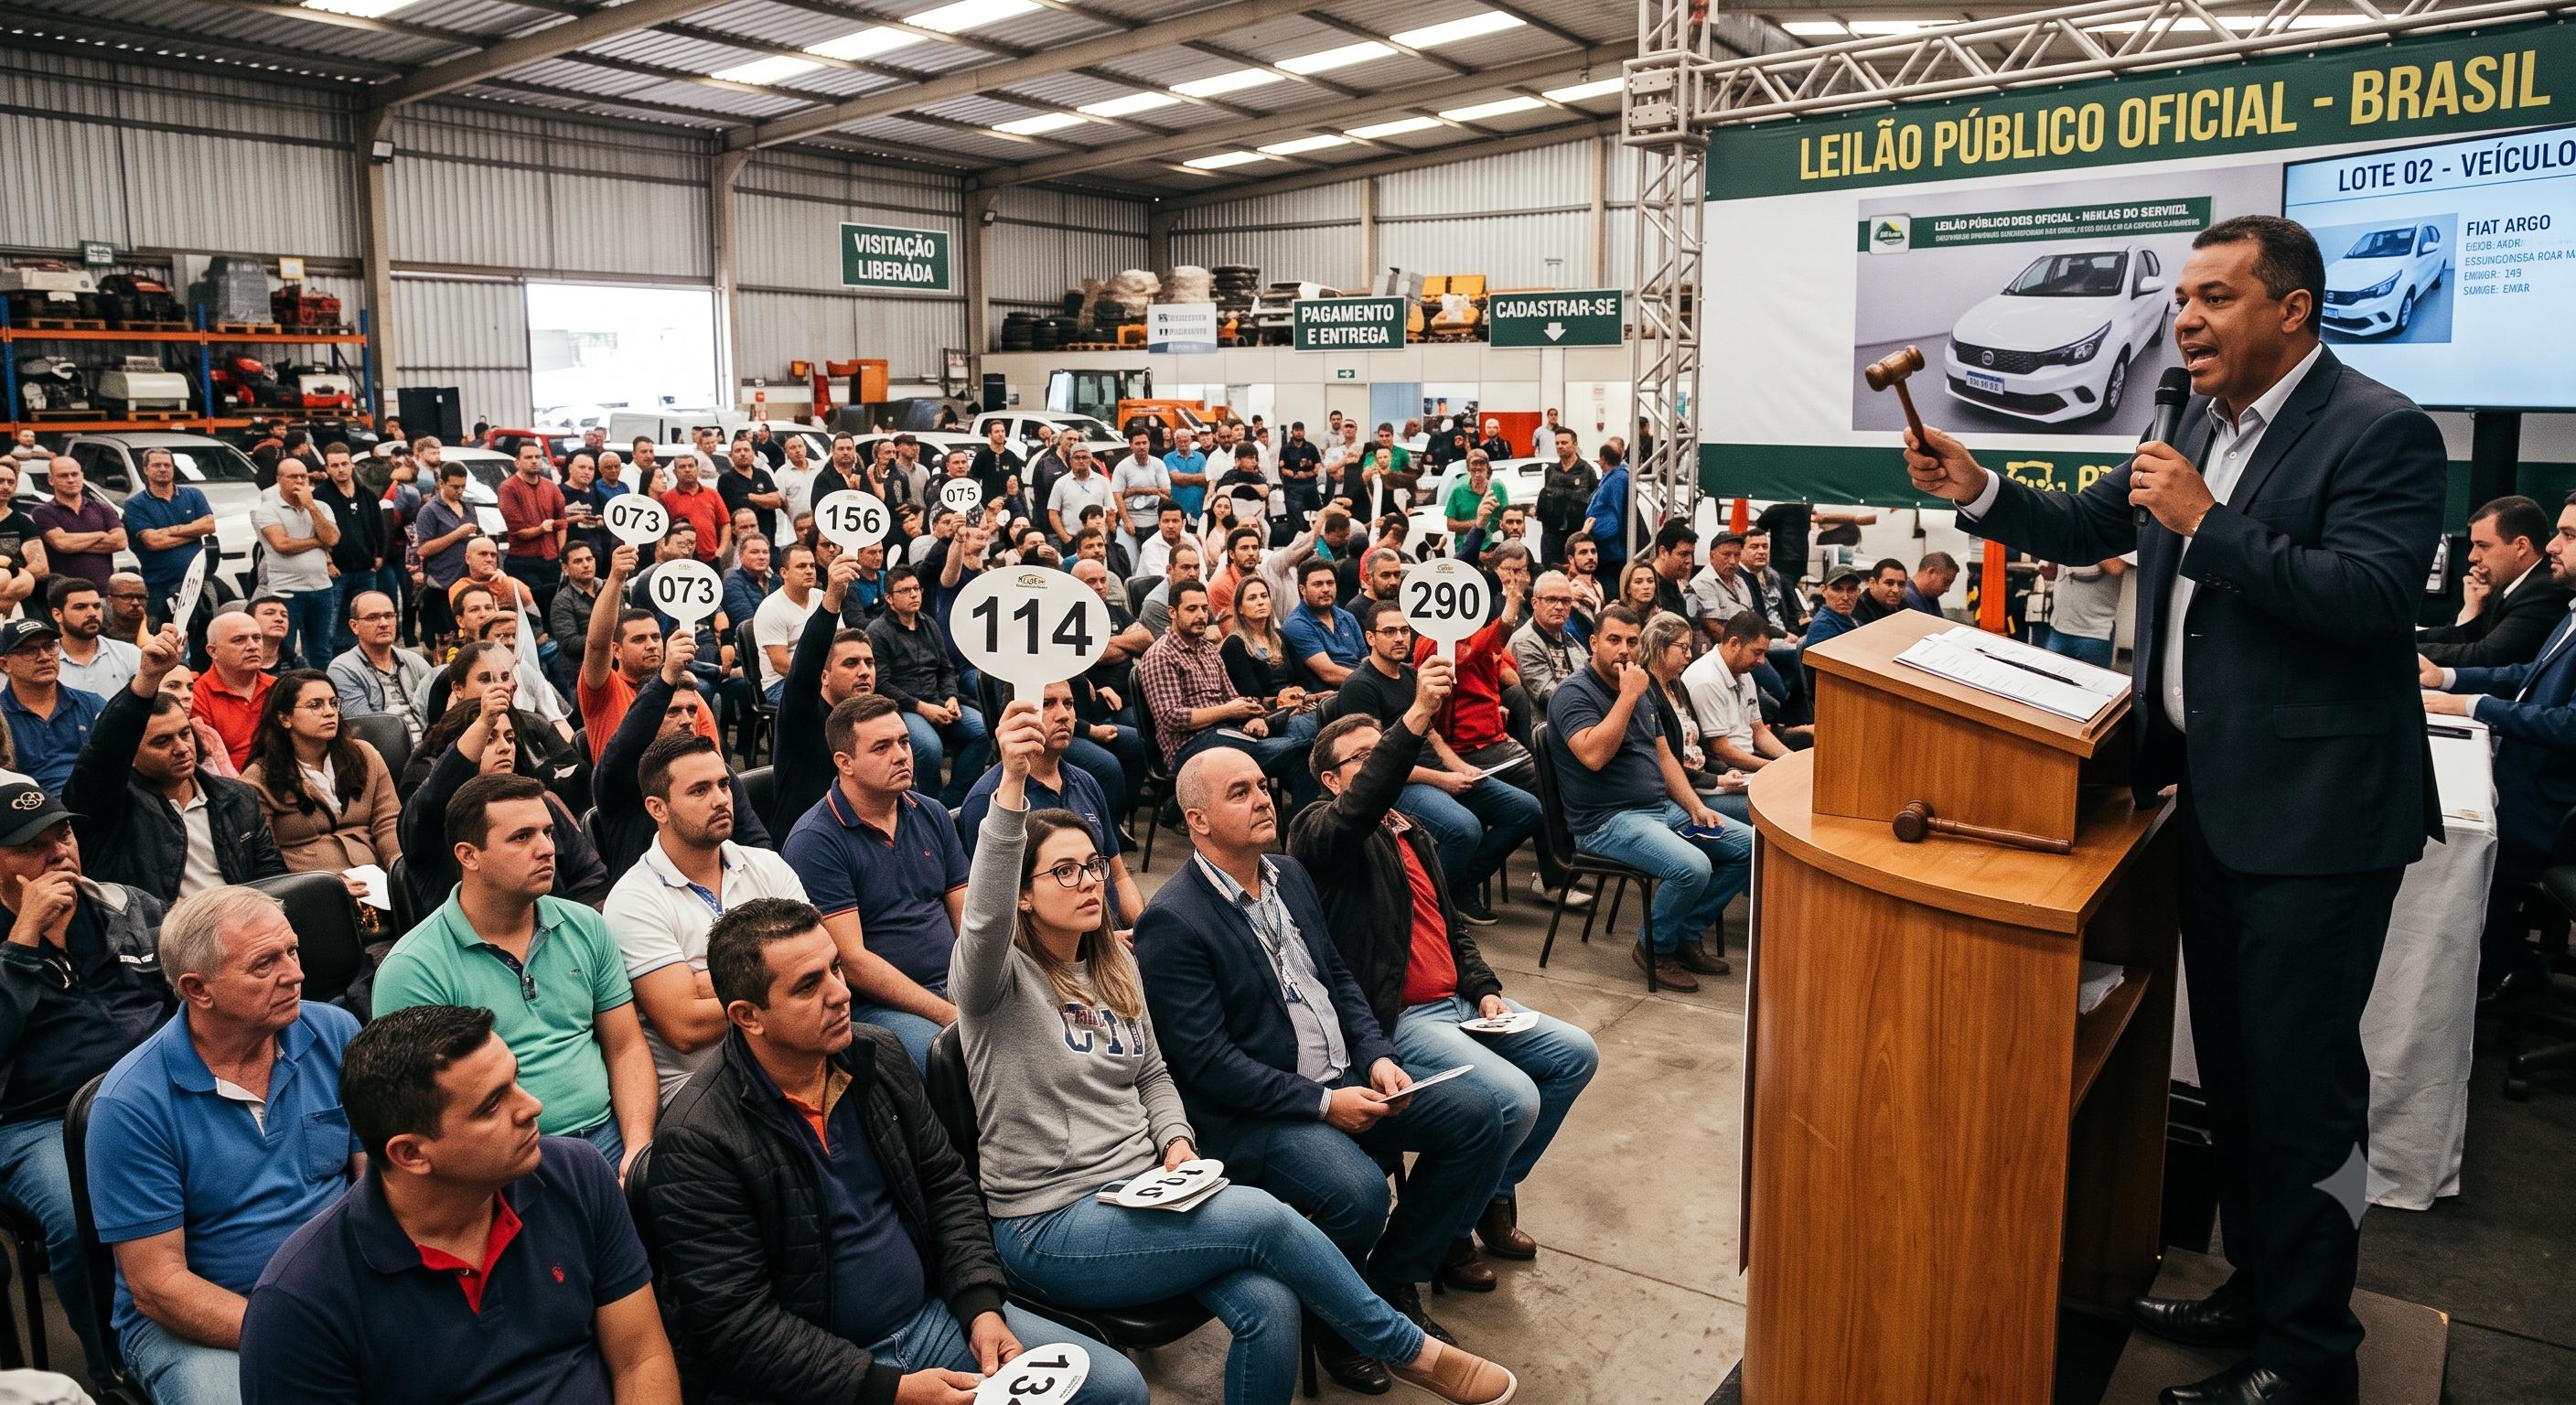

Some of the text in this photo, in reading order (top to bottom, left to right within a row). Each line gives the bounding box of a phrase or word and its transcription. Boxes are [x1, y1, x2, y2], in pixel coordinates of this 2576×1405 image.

[1799, 49, 2550, 180] LEILÃO PÚBLICO OFICIAL - BRASIL
[2338, 163, 2395, 192] LOTE
[2404, 158, 2433, 185] 02
[2461, 141, 2576, 177] VEÍCULO
[1969, 216, 2011, 230] PÚBLICO
[2034, 212, 2074, 225] OFICIAL
[2466, 214, 2551, 237] FIAT ARGO
[853, 232, 936, 262] VISITAÇÃO
[858, 259, 935, 284] LIBERADA
[1301, 304, 1395, 323] PAGAMENTO
[1496, 297, 1616, 318] CADASTRAR-SE
[1307, 327, 1390, 345] E ENTREGA
[946, 487, 976, 502] 075
[612, 504, 660, 532] 073
[825, 504, 881, 533] 156
[659, 575, 714, 604] 073
[1410, 581, 1480, 620] 290
[972, 595, 1093, 657] 114
